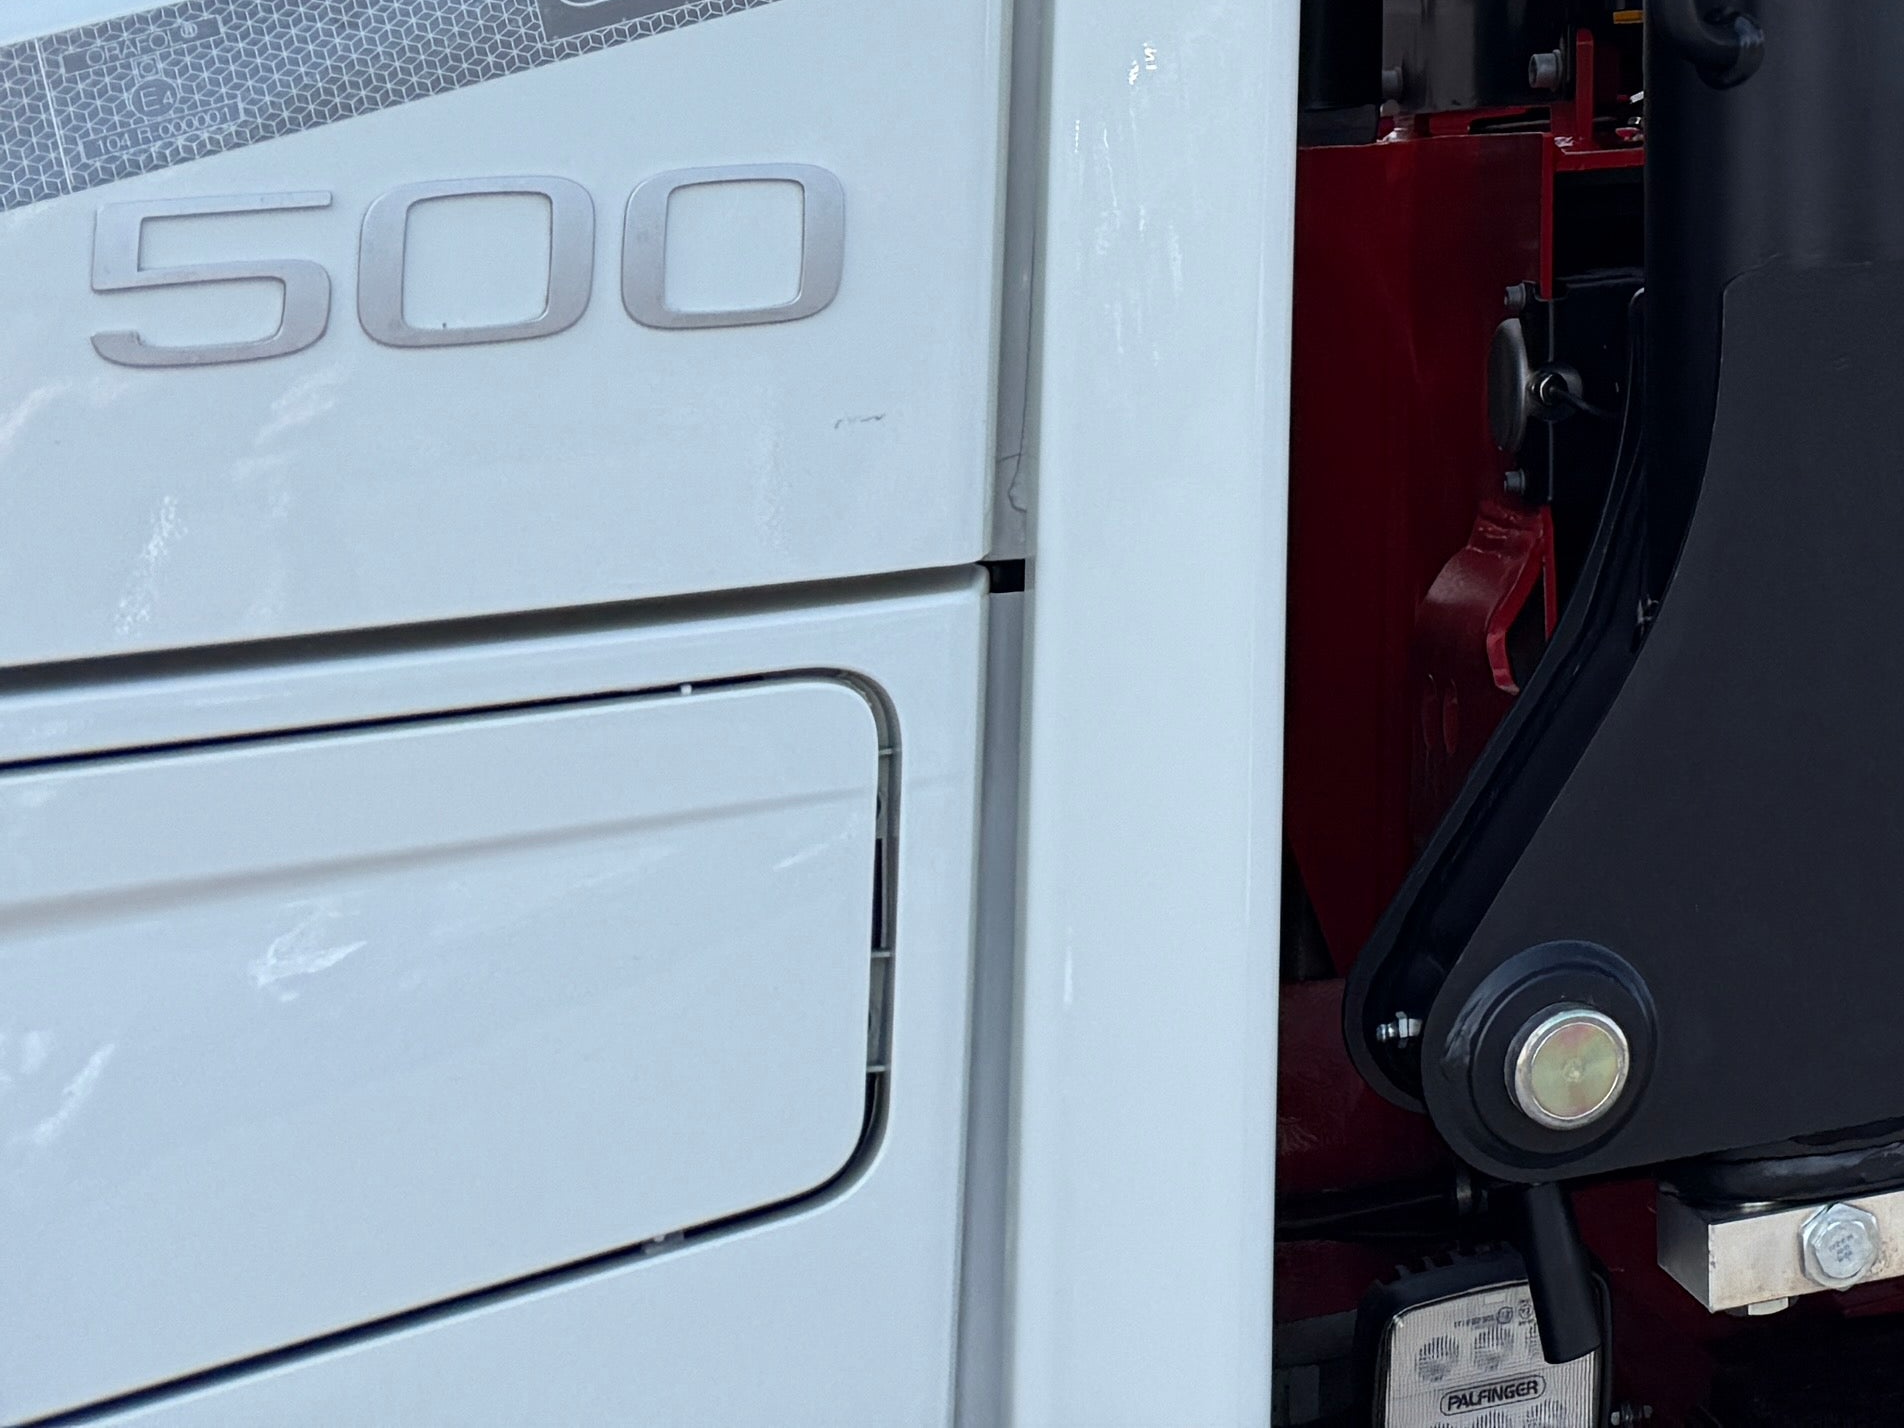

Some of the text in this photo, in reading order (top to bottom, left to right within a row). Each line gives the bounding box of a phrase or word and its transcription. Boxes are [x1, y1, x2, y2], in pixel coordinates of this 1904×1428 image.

[97, 132, 131, 155] 104
[90, 162, 845, 369] 500
[1447, 1379, 1539, 1412] PALFINGER
